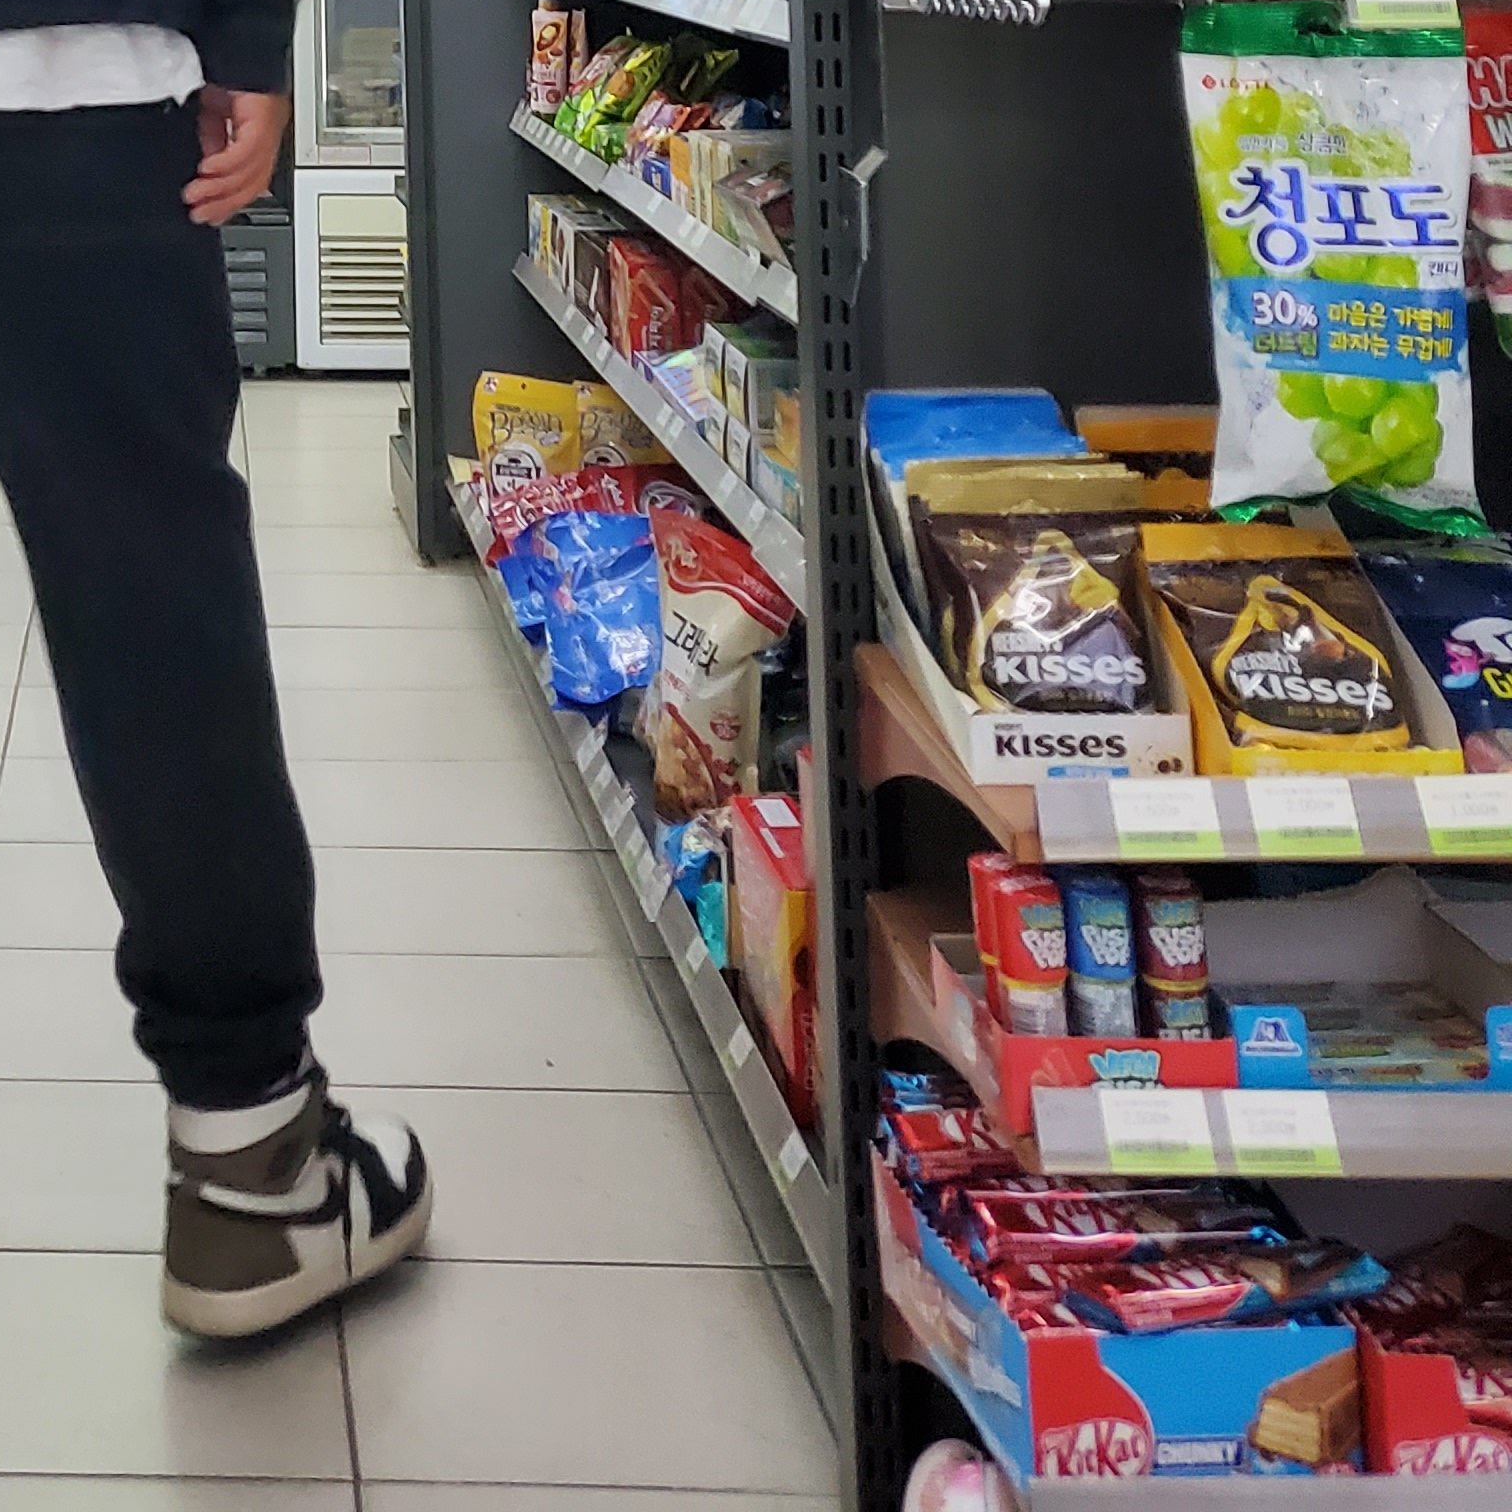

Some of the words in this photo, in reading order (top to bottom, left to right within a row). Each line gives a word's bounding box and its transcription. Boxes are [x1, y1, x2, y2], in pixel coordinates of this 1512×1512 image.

[1224, 165, 1460, 267] 청포도
[1252, 290, 1319, 328] 30%
[1327, 300, 1388, 329] 마음은
[1392, 305, 1454, 332] 가볍게
[1327, 330, 1390, 358] 과자는
[1395, 334, 1453, 362] 무겁게
